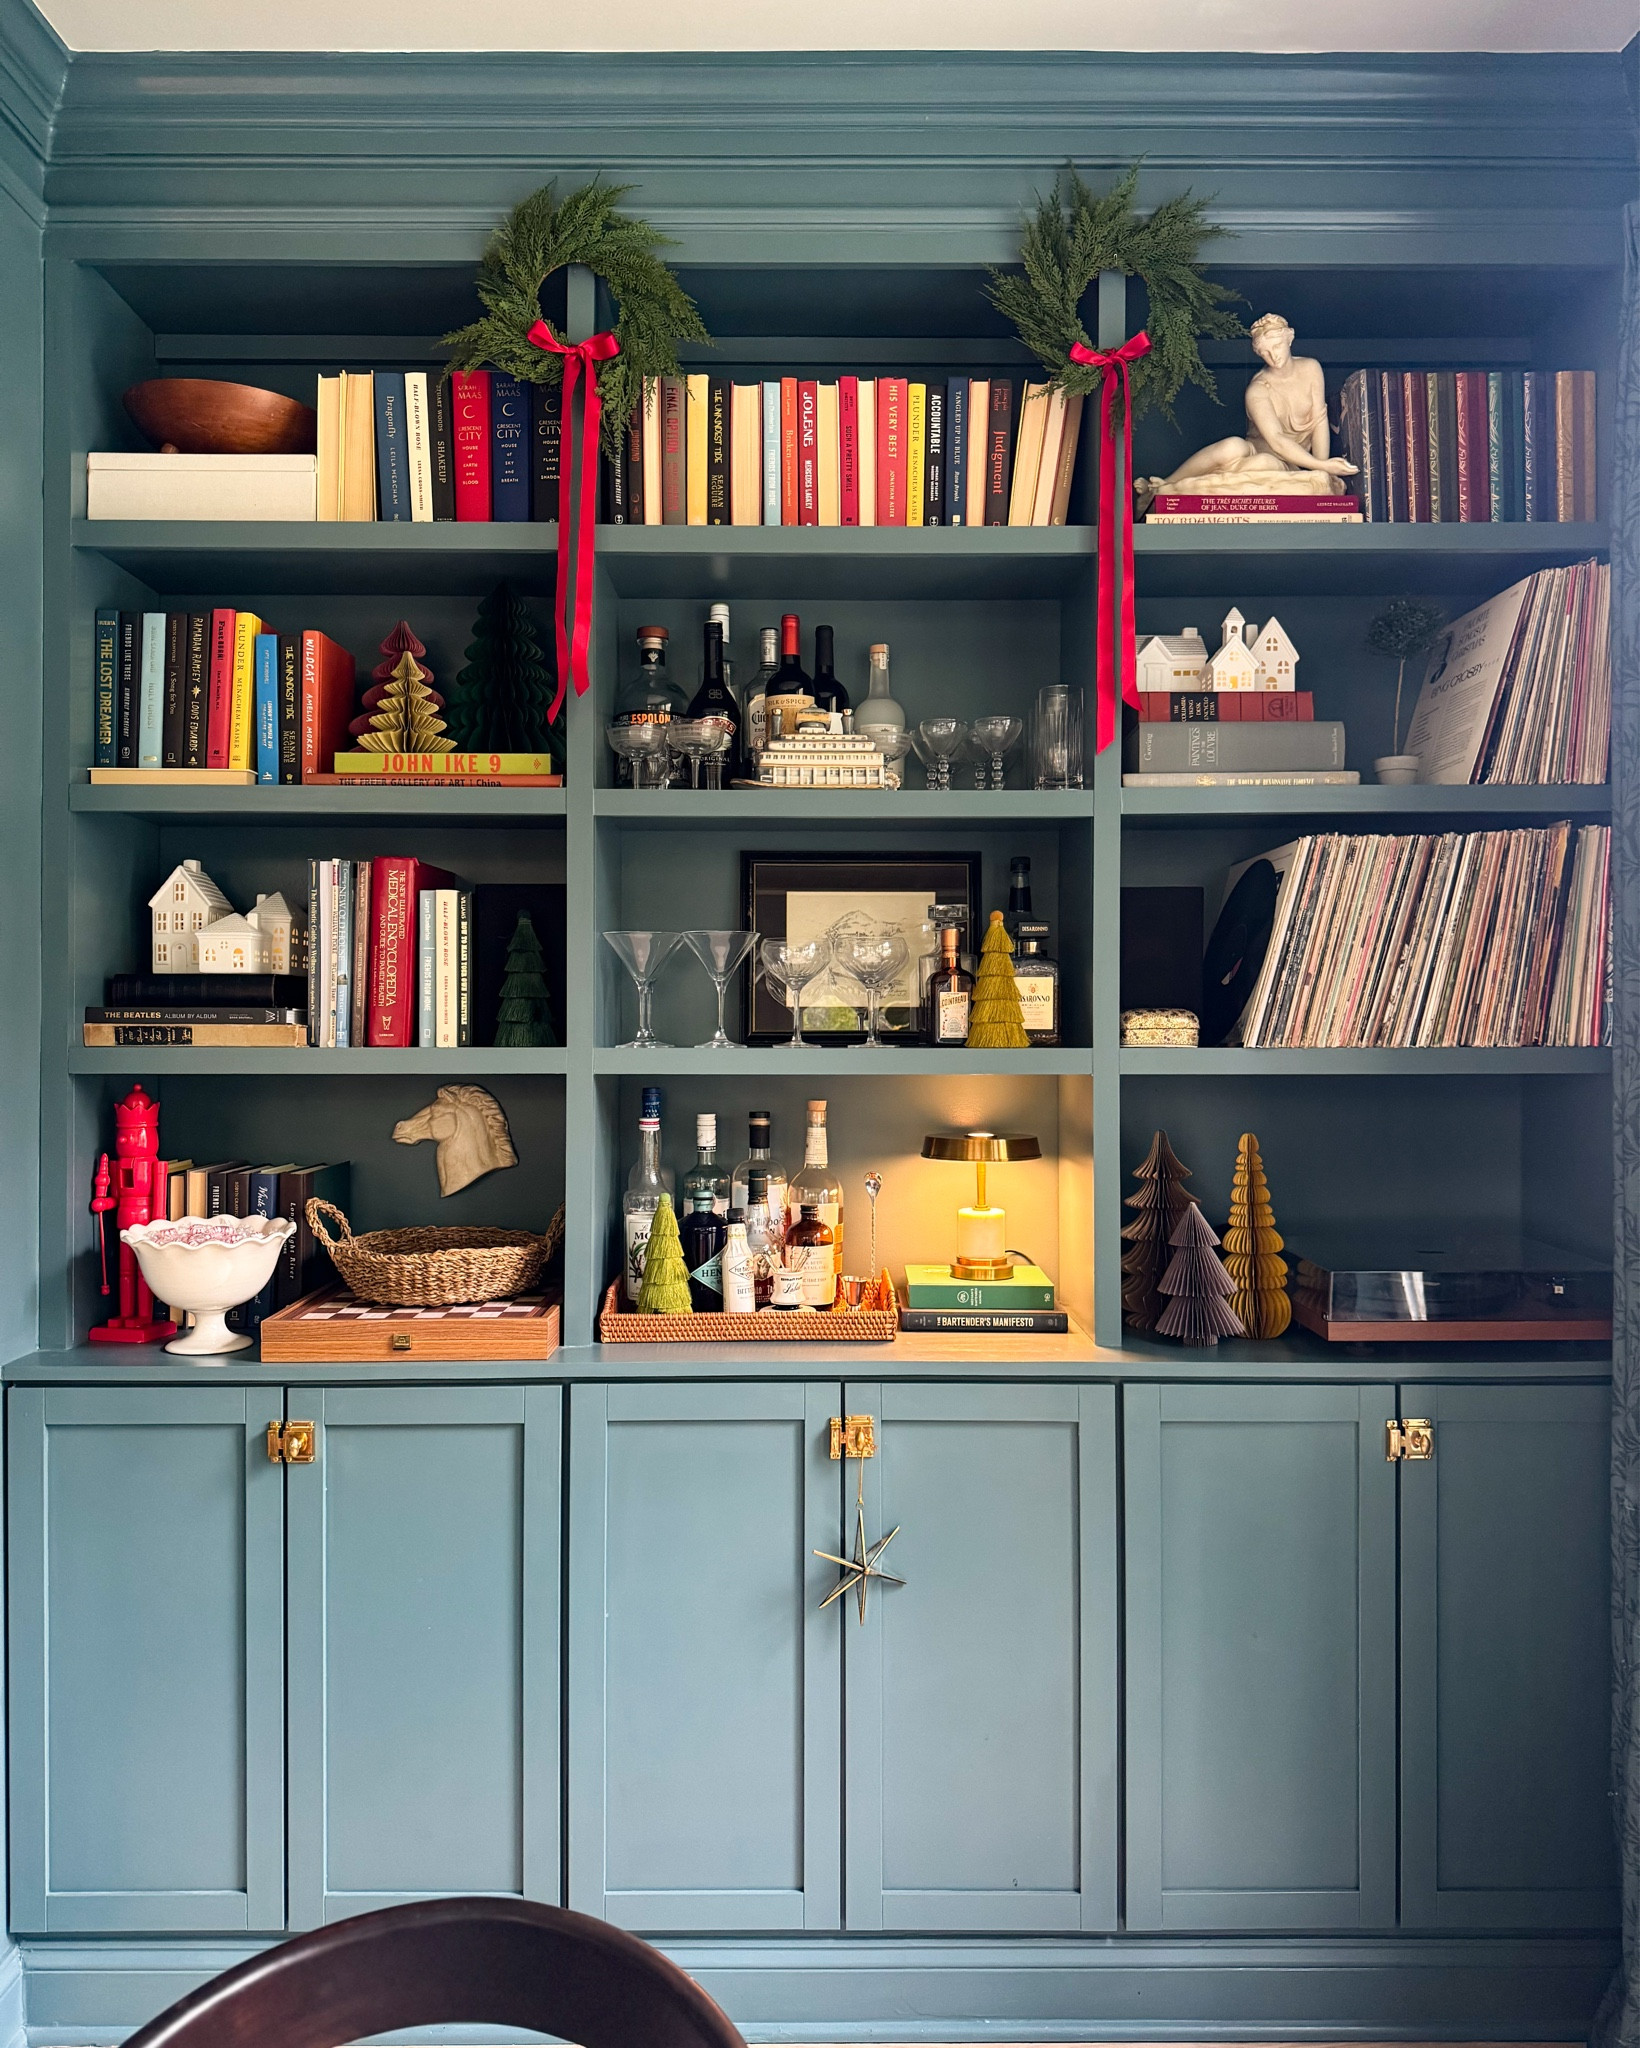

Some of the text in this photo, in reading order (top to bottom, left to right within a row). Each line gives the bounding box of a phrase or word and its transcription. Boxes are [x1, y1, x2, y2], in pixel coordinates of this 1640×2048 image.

[458, 392, 482, 400] MAAS
[496, 389, 521, 397] MAAS
[666, 387, 678, 415] FINAL
[993, 388, 1002, 412] Finder
[385, 395, 396, 439] Dragonfly
[714, 389, 722, 464] THE UNKINDEST TIDE
[803, 392, 813, 447] JOLENE
[888, 385, 898, 459] HIS VERY BEST
[912, 395, 920, 442] PLUNDER
[930, 394, 941, 454] ACCOUNTABLE
[955, 425, 961, 435] UP
[458, 432, 482, 440] CITY
[497, 429, 521, 438] CITY
[667, 418, 679, 453] OPTION
[785, 430, 794, 458] Broken
[845, 425, 853, 442] SUCH
[955, 436, 961, 444] IN
[437, 440, 446, 484] SHAKEUP
[991, 431, 1007, 495] Judgment
[391, 469, 399, 505] MEACHAM
[768, 449, 776, 506] FRIENDS HOME
[805, 489, 813, 510] LACKEY
[217, 621, 226, 640] Fast
[192, 617, 203, 683] RAMADAN RAMSEY
[237, 624, 246, 671] PLUNDER
[305, 638, 315, 683] WILDCAT
[99, 637, 112, 745] THE LOST DREAMER
[169, 678, 177, 692] Song
[286, 660, 294, 701] UNKINDEST
[235, 677, 243, 721] MENACHEM
[286, 703, 294, 720] TIDE
[189, 701, 200, 752] LOUIS EDWARDS
[1191, 727, 1200, 766] PAINTINGS
[1206, 731, 1215, 762] LOUVRE
[382, 754, 501, 772] JOHN IKE 9
[339, 777, 502, 787] THE FREER GALLERY OF ART China
[338, 886, 346, 960] NEW OLD HOUSE
[385, 870, 398, 1006] MEDICAL ENCYCLOPEDIA
[461, 936, 467, 944] TO
[379, 949, 385, 959] TO
[424, 956, 432, 978] FRIENDS
[942, 994, 967, 1006] COINTREAU
[257, 1186, 269, 1207] White
[288, 1202, 296, 1222] Long
[942, 1317, 1034, 1327] BARTENDER'S MANIFESTO
